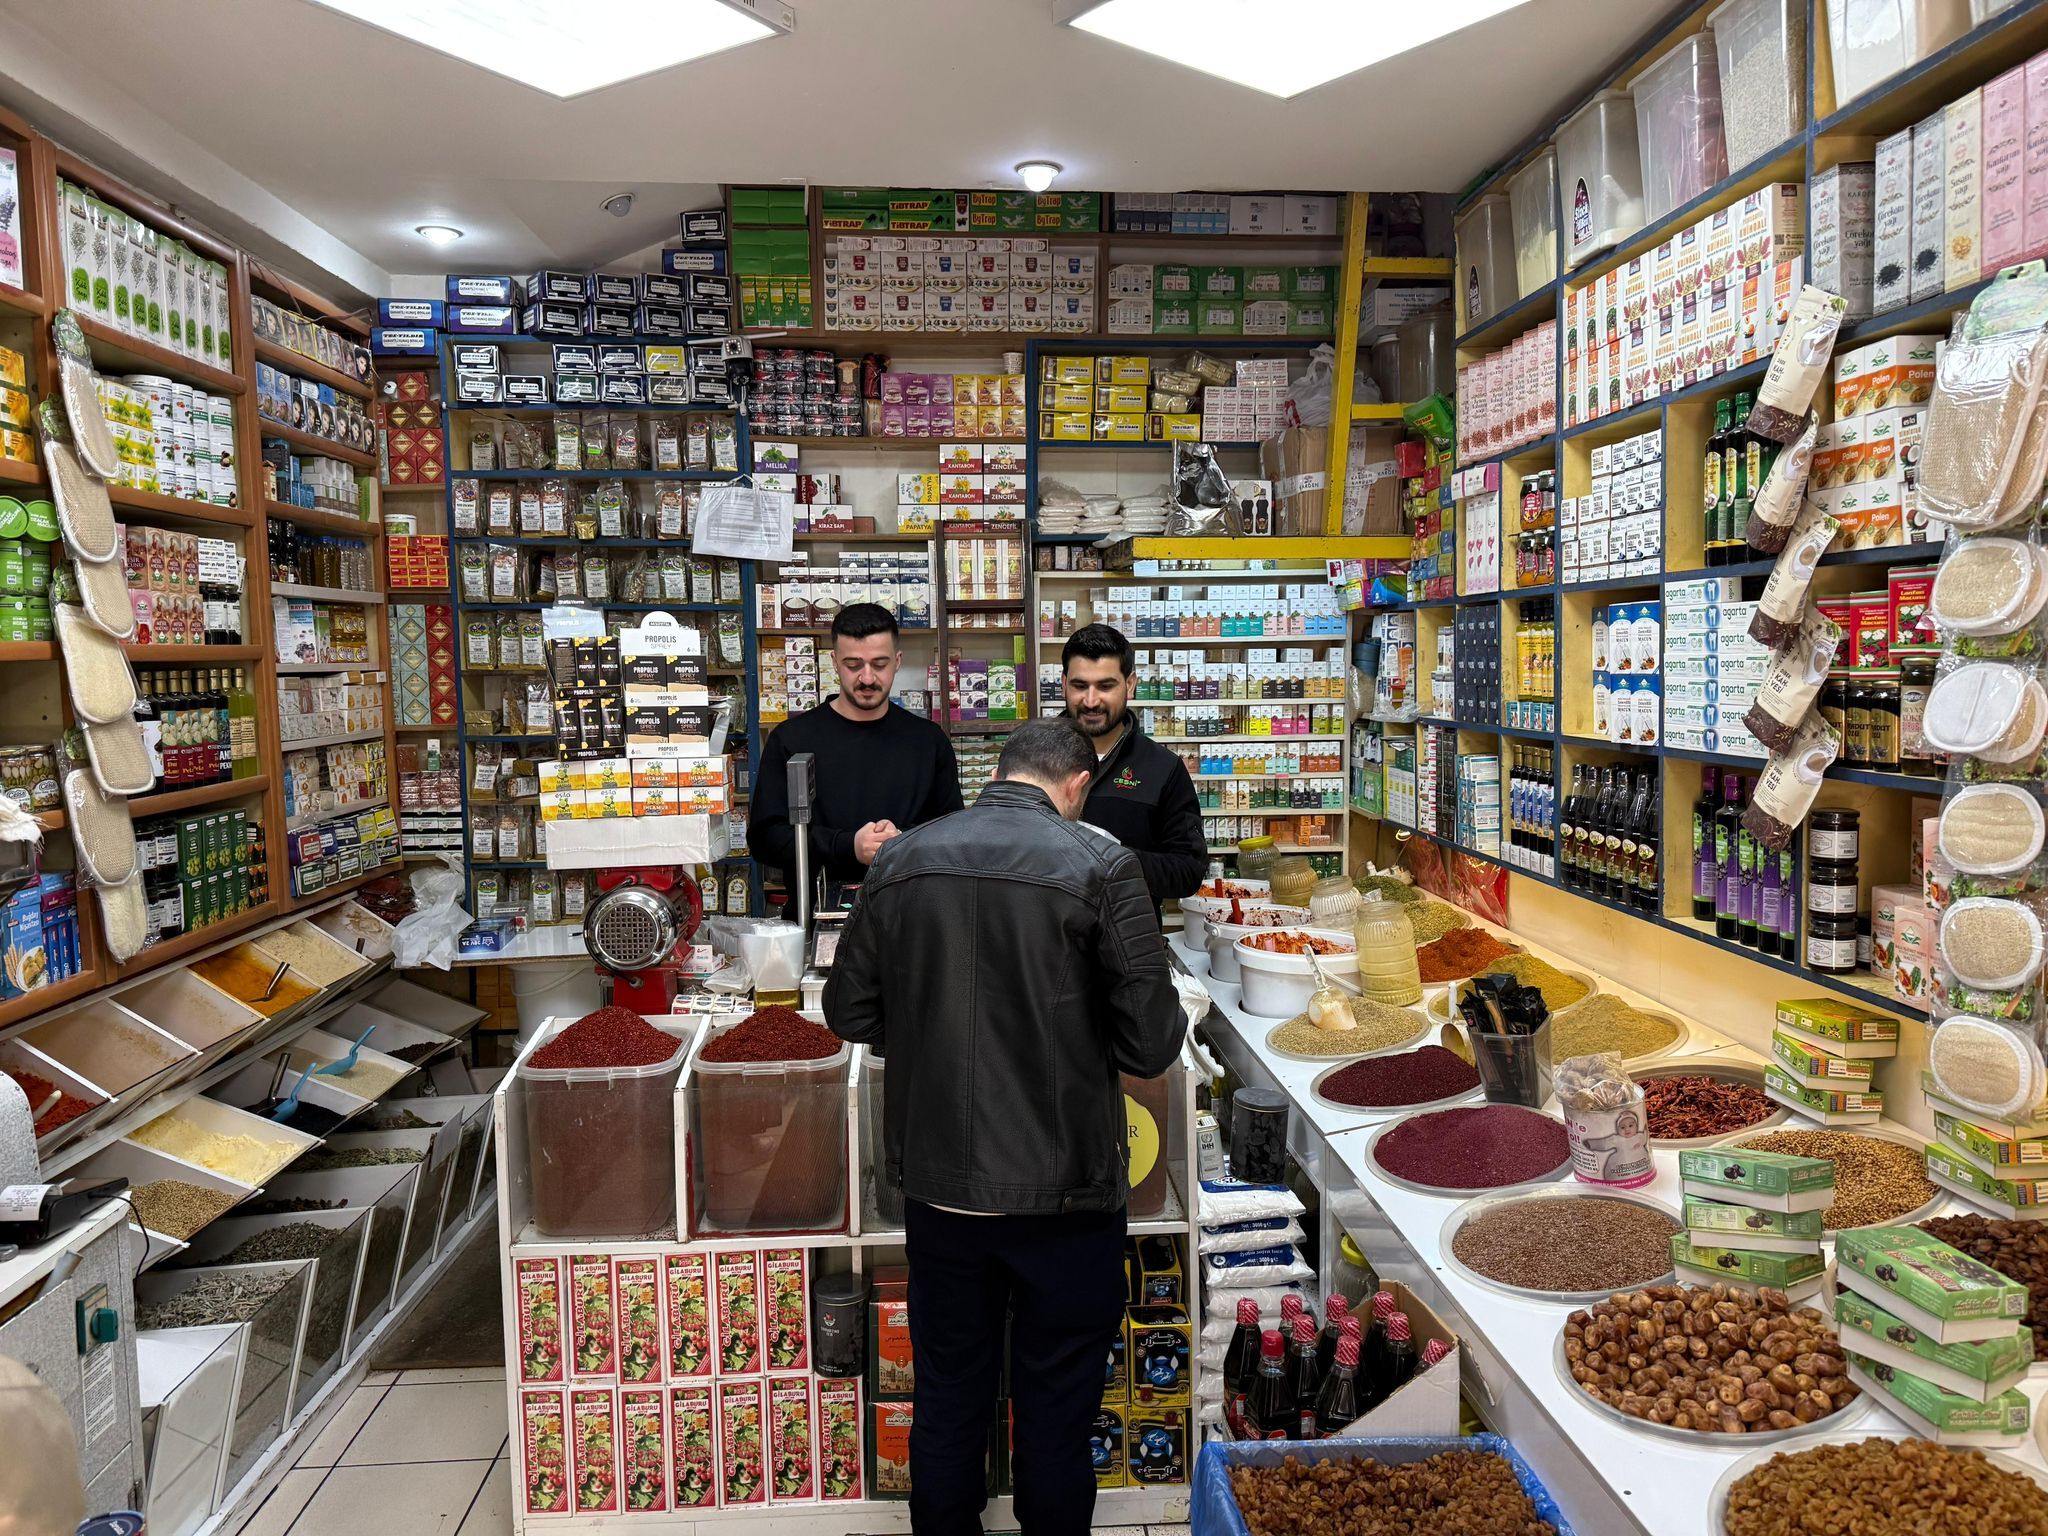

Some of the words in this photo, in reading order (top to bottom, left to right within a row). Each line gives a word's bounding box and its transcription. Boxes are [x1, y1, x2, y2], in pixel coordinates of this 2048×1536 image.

[1950, 172, 1973, 190] Susam
[973, 194, 997, 206] ByTrap
[1037, 195, 1061, 206] ByTrap
[973, 212, 998, 224] ByTrap
[1036, 214, 1062, 226] ByTrap
[1872, 373, 1891, 386] Polen
[1908, 370, 1934, 379] Polen
[1840, 383, 1858, 394] Polen
[1873, 444, 1891, 455] Polen
[1814, 456, 1831, 465] Polen
[1842, 450, 1859, 461] Polen
[766, 461, 787, 469] MELİSA
[991, 462, 1018, 470] ZENCEFİL
[991, 492, 1018, 500] ZENCEFİL
[1840, 517, 1858, 526] Polen
[1871, 512, 1890, 522] Polen
[906, 523, 932, 531] PAPATYA
[991, 522, 1018, 530] ZENCEFİL
[1665, 588, 1686, 598] agarta
[1668, 612, 1688, 623] agarta
[1722, 607, 1747, 620] agarta
[645, 635, 677, 643] PROPOLİS
[1666, 636, 1686, 647] agarta
[1720, 634, 1745, 646] agarta
[633, 665, 658, 673] PROPOLİS
[675, 665, 699, 673] PROPOLİS
[1665, 660, 1686, 671] agarta
[1720, 659, 1745, 671] agarta
[1666, 683, 1686, 695] agarta
[1721, 684, 1745, 695] agarta
[1666, 707, 1685, 717] agarta
[1722, 711, 1745, 722] agarta
[635, 716, 660, 725] PROPOLİS
[676, 716, 701, 724] PROPOLİS
[1665, 730, 1685, 740] agarta
[1722, 735, 1746, 747] agarta
[575, 1281, 586, 1346] GİLABURU
[720, 1281, 731, 1347] GİLABURU
[768, 1277, 779, 1343] GİLABURU
[522, 1288, 533, 1354] GİLABURU
[671, 1283, 682, 1349] GİLABURU
[620, 1290, 631, 1356] GİLABURU
[773, 1406, 784, 1471] GİLABURU
[821, 1408, 833, 1473] GİLABURU
[675, 1416, 687, 1481] GİLABURU
[725, 1412, 736, 1477] GİLABURU
[527, 1420, 539, 1485] GİLABURU
[576, 1419, 587, 1485] GİLABURU
[625, 1420, 636, 1485] GİLABURU
